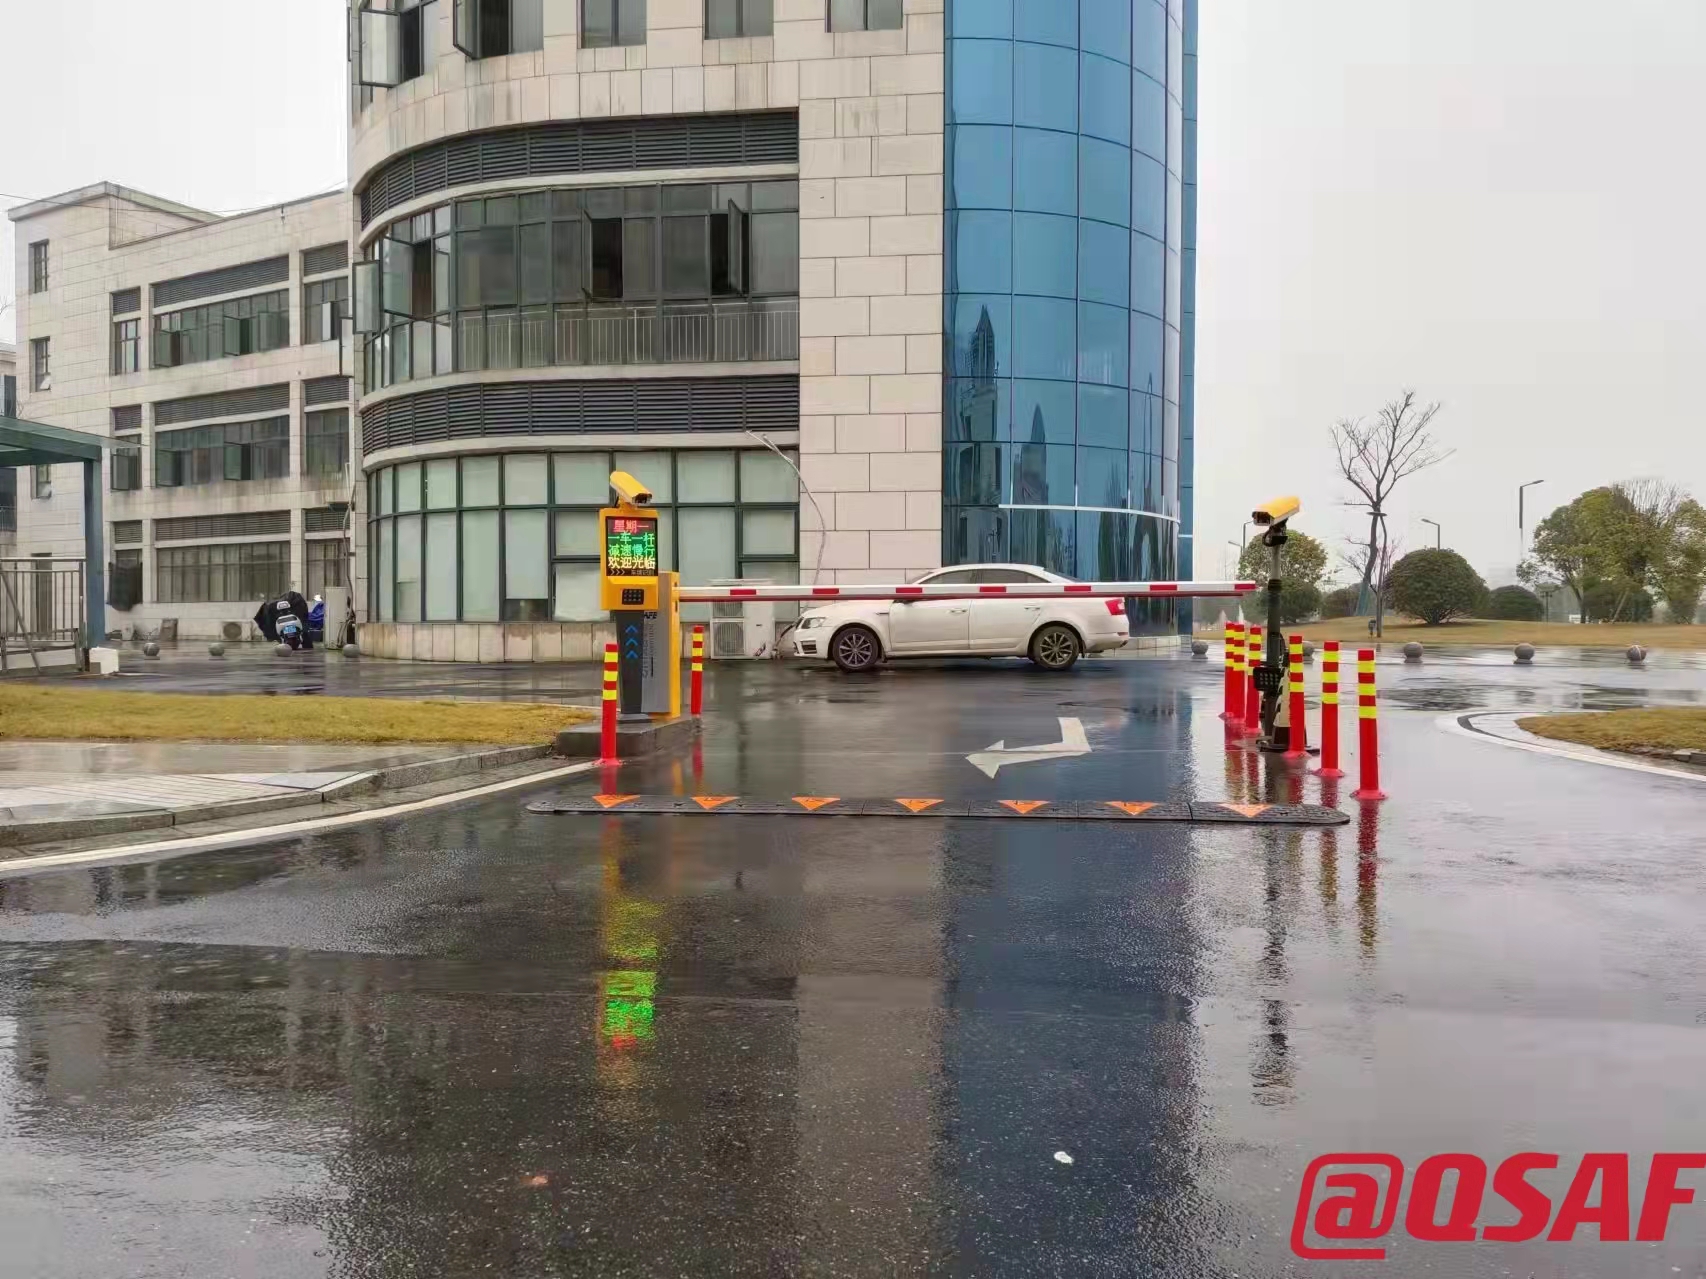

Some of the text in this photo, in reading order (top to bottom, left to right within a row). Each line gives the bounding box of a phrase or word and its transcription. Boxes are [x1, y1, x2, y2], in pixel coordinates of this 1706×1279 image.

[613, 519, 650, 533] 星期一
[608, 531, 655, 545] 一车一杆
[608, 544, 655, 558] 减速慢行
[608, 556, 656, 570] 欢迎光临
